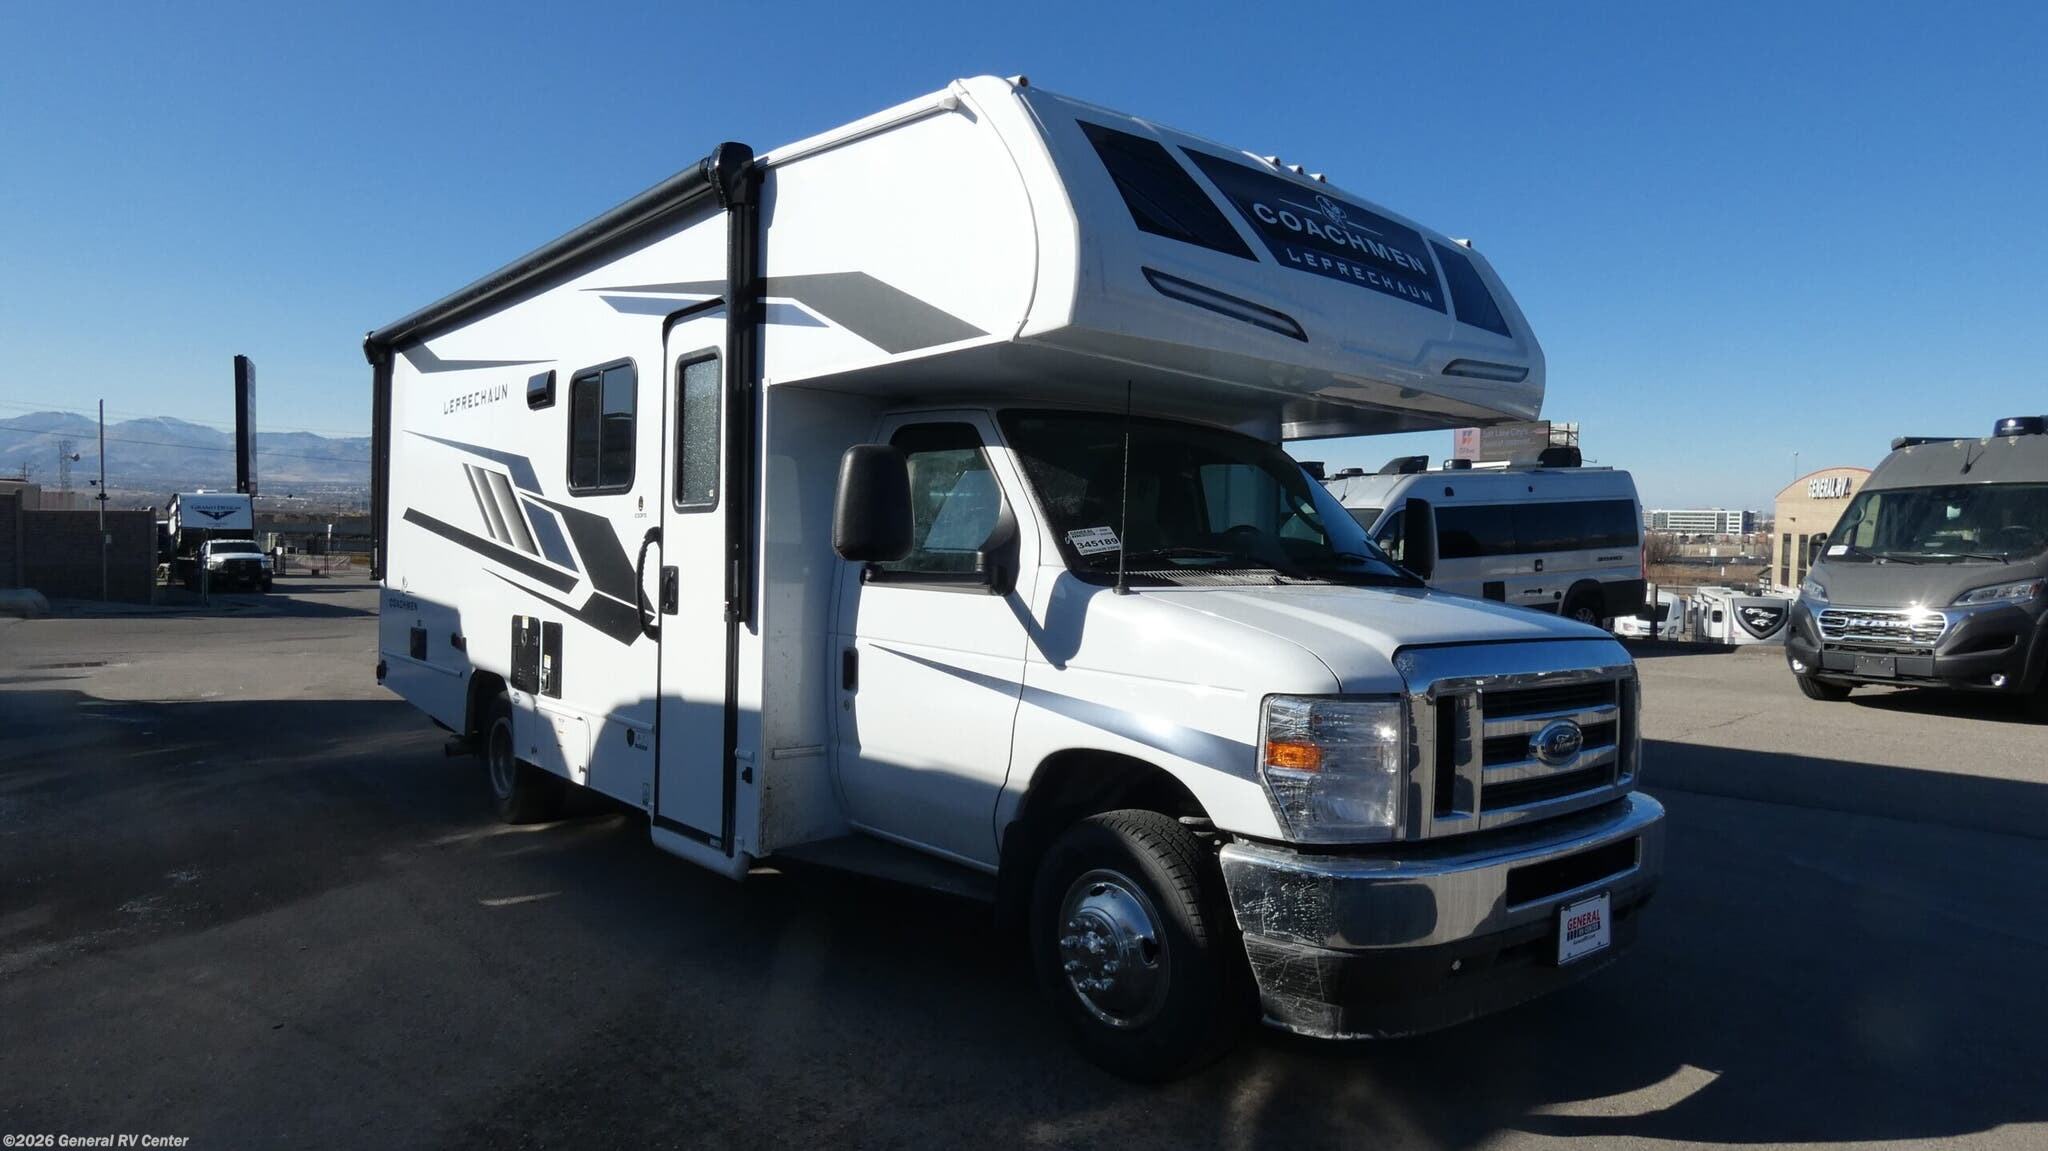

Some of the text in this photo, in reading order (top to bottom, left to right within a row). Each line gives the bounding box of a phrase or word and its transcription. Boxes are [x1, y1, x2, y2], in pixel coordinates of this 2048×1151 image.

[1253, 203, 1427, 275] COACHMEN
[1286, 247, 1432, 303] LEPRECHAUN
[443, 383, 508, 415] LEPRECHAUN
[1807, 478, 1835, 499] GENERAL
[1077, 537, 1119, 549] 345189
[1567, 909, 1600, 931] GENERAL
